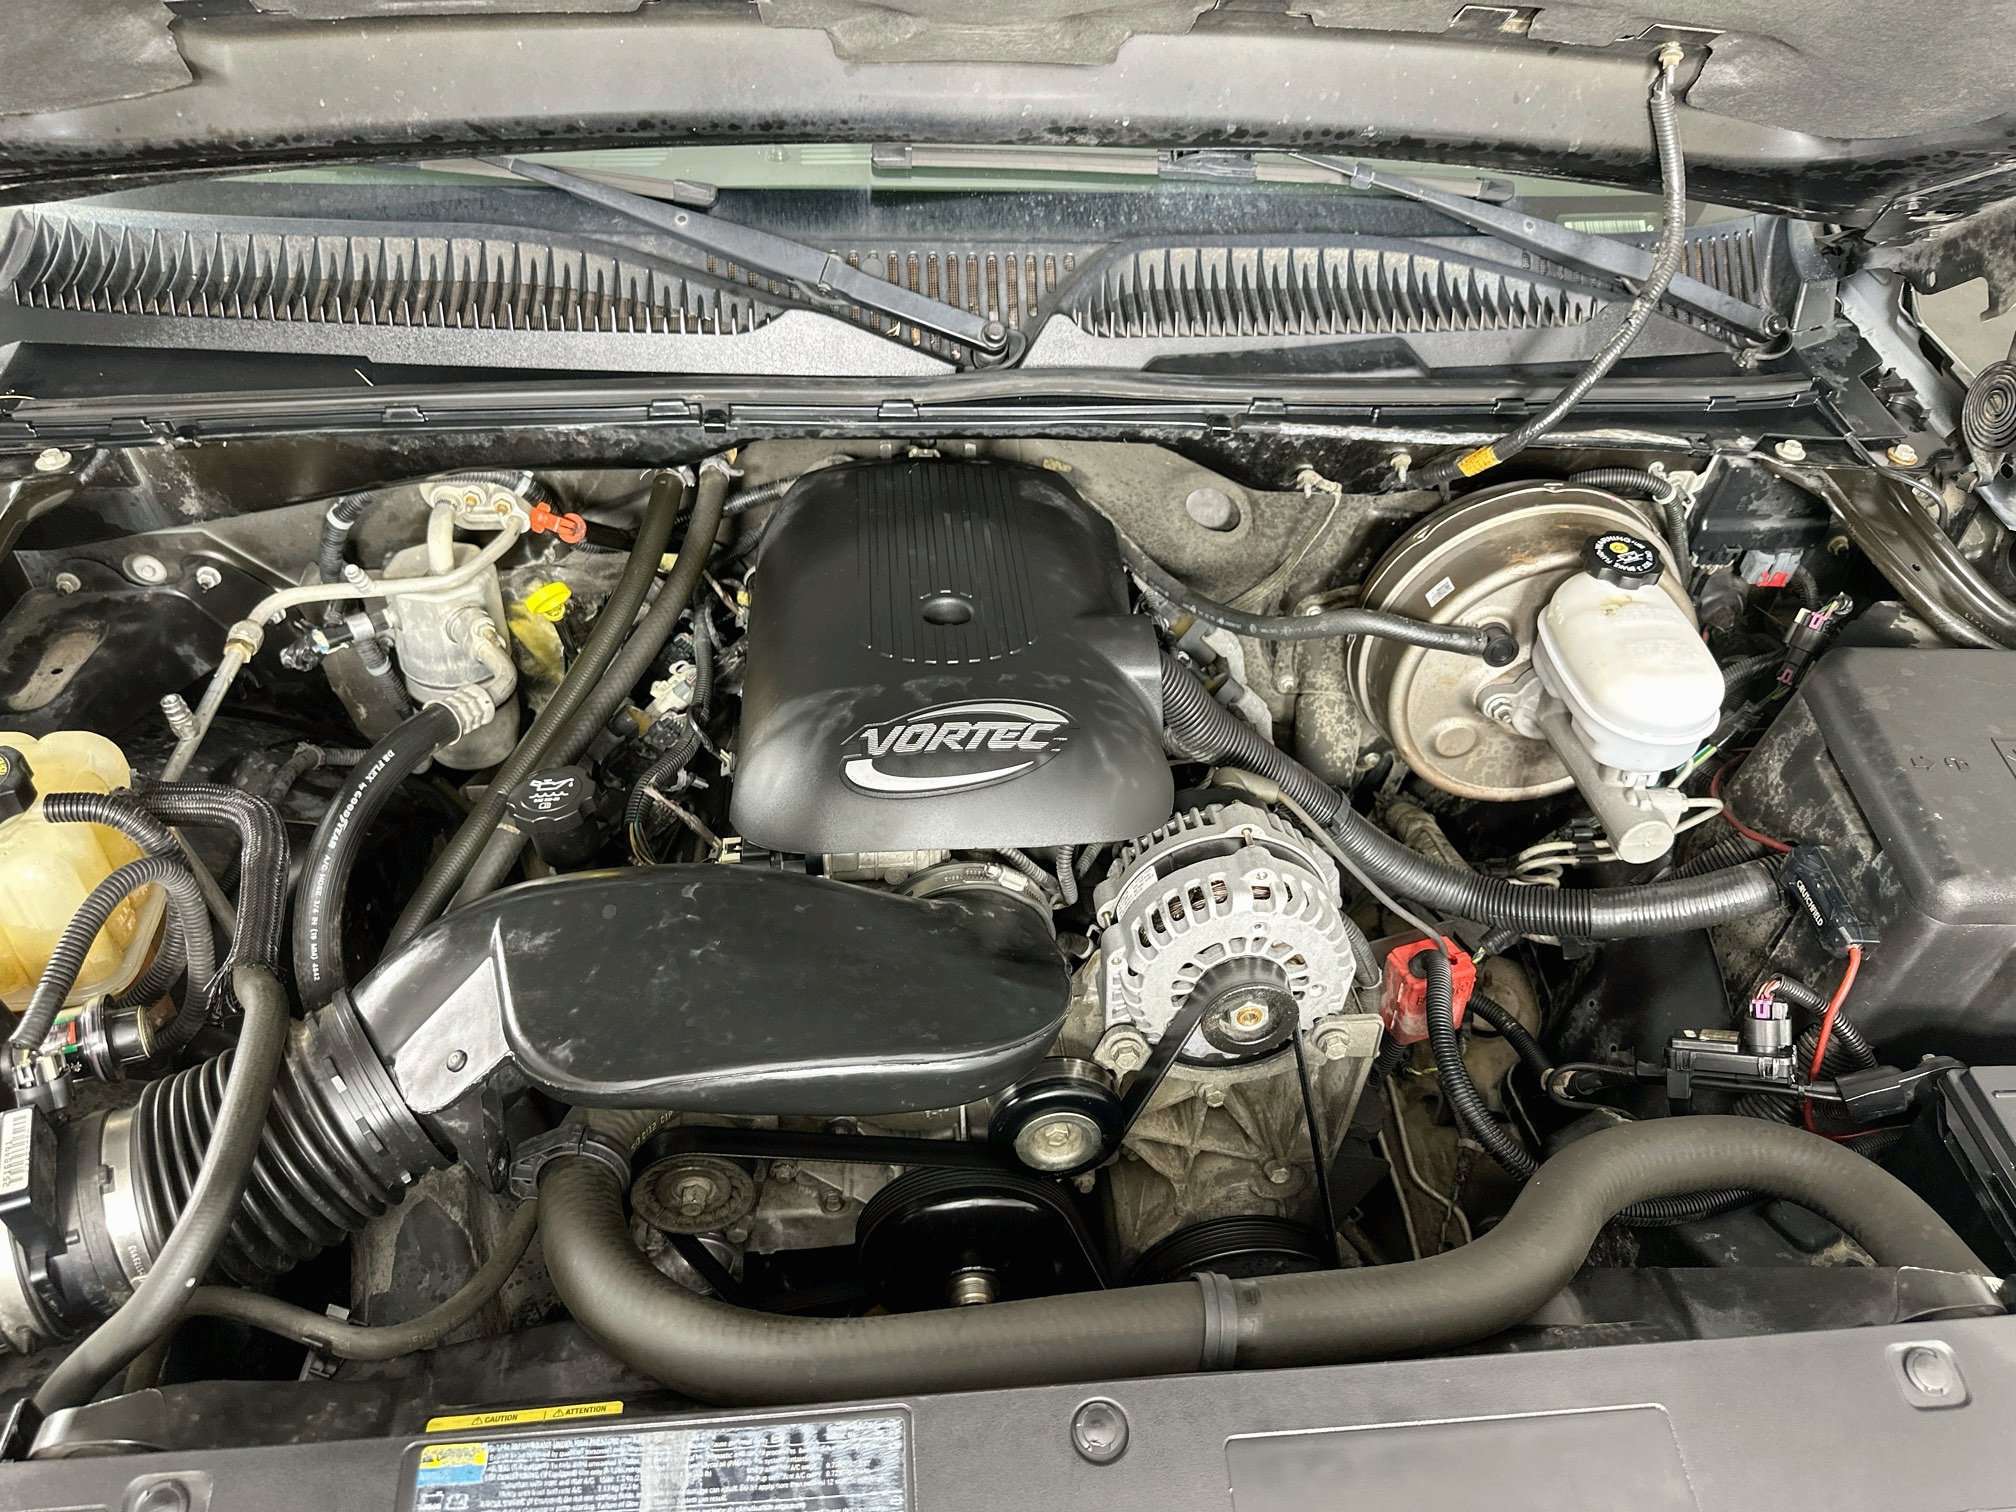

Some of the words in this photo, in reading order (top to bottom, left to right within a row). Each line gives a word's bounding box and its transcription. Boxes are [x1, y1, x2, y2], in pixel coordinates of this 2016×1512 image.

[1594, 536, 1630, 550] WARNING
[860, 721, 1061, 756] VORTEC
[328, 790, 363, 850] GOODYEAR
[322, 855, 331, 873] A/C
[317, 874, 326, 897] HOSE
[1796, 880, 1824, 926] CRUTCHFIELD
[484, 1414, 518, 1424] CAUTION
[564, 1405, 606, 1416] ATTENTION
